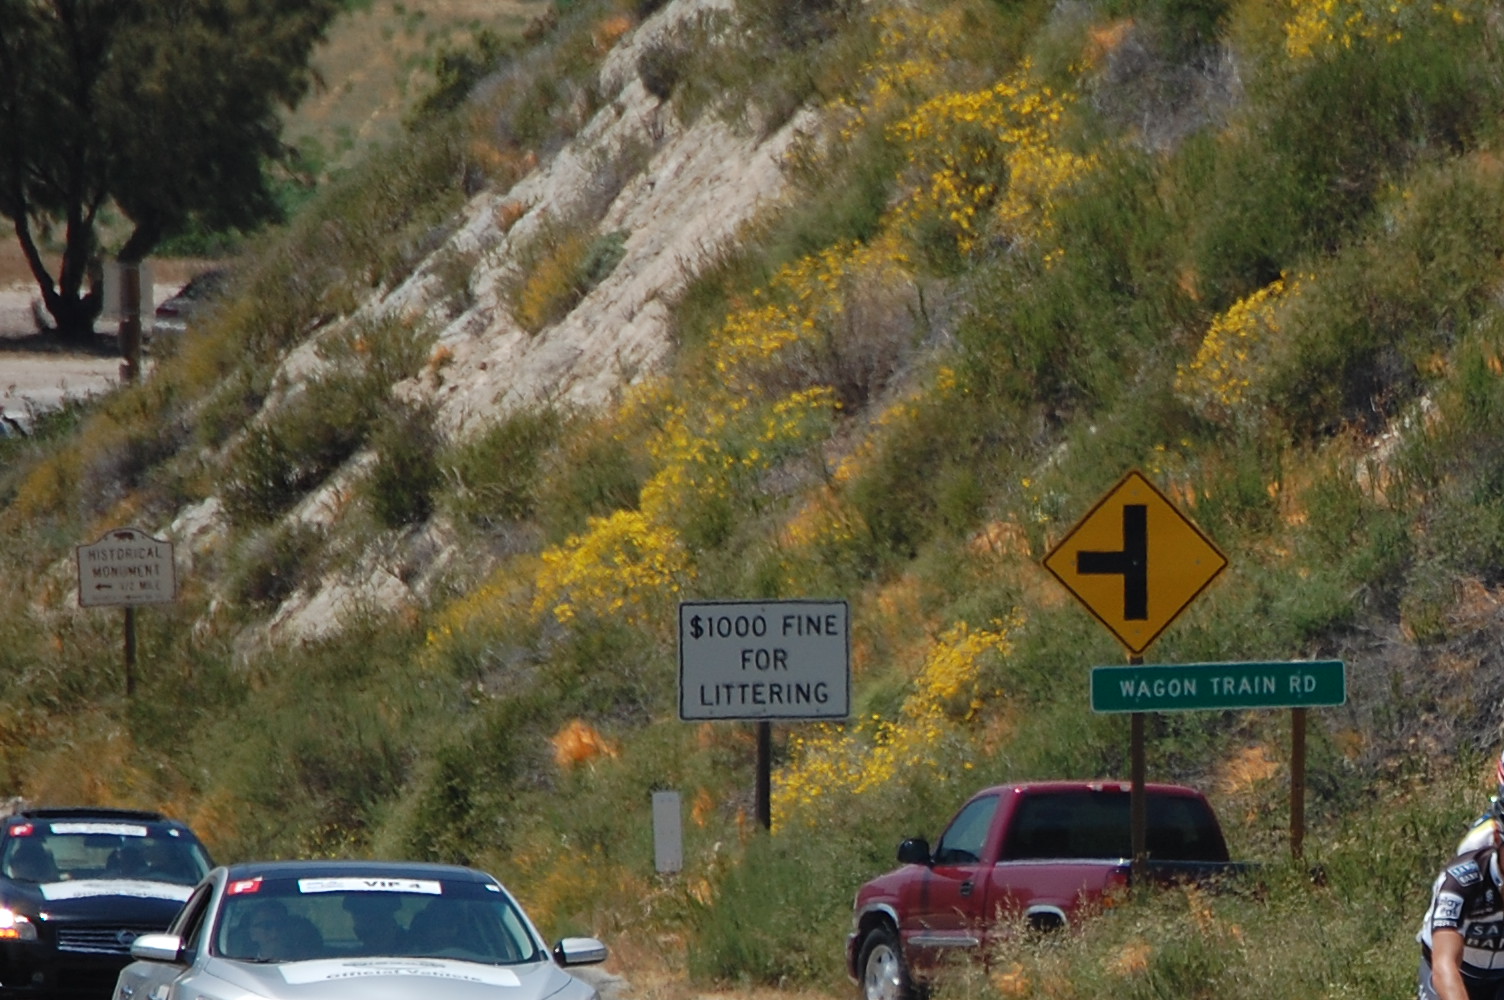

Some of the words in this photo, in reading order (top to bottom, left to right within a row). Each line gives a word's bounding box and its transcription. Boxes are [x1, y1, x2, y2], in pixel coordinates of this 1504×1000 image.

[88, 547, 162, 561] HISTORICAL
[689, 613, 768, 641] $1000
[782, 614, 839, 637] FINE
[740, 647, 789, 672] FOR
[700, 681, 829, 707] LITTERING
[1119, 678, 1198, 698] WAGON
[1210, 676, 1277, 696] TRAIN
[1289, 674, 1318, 693] RD
